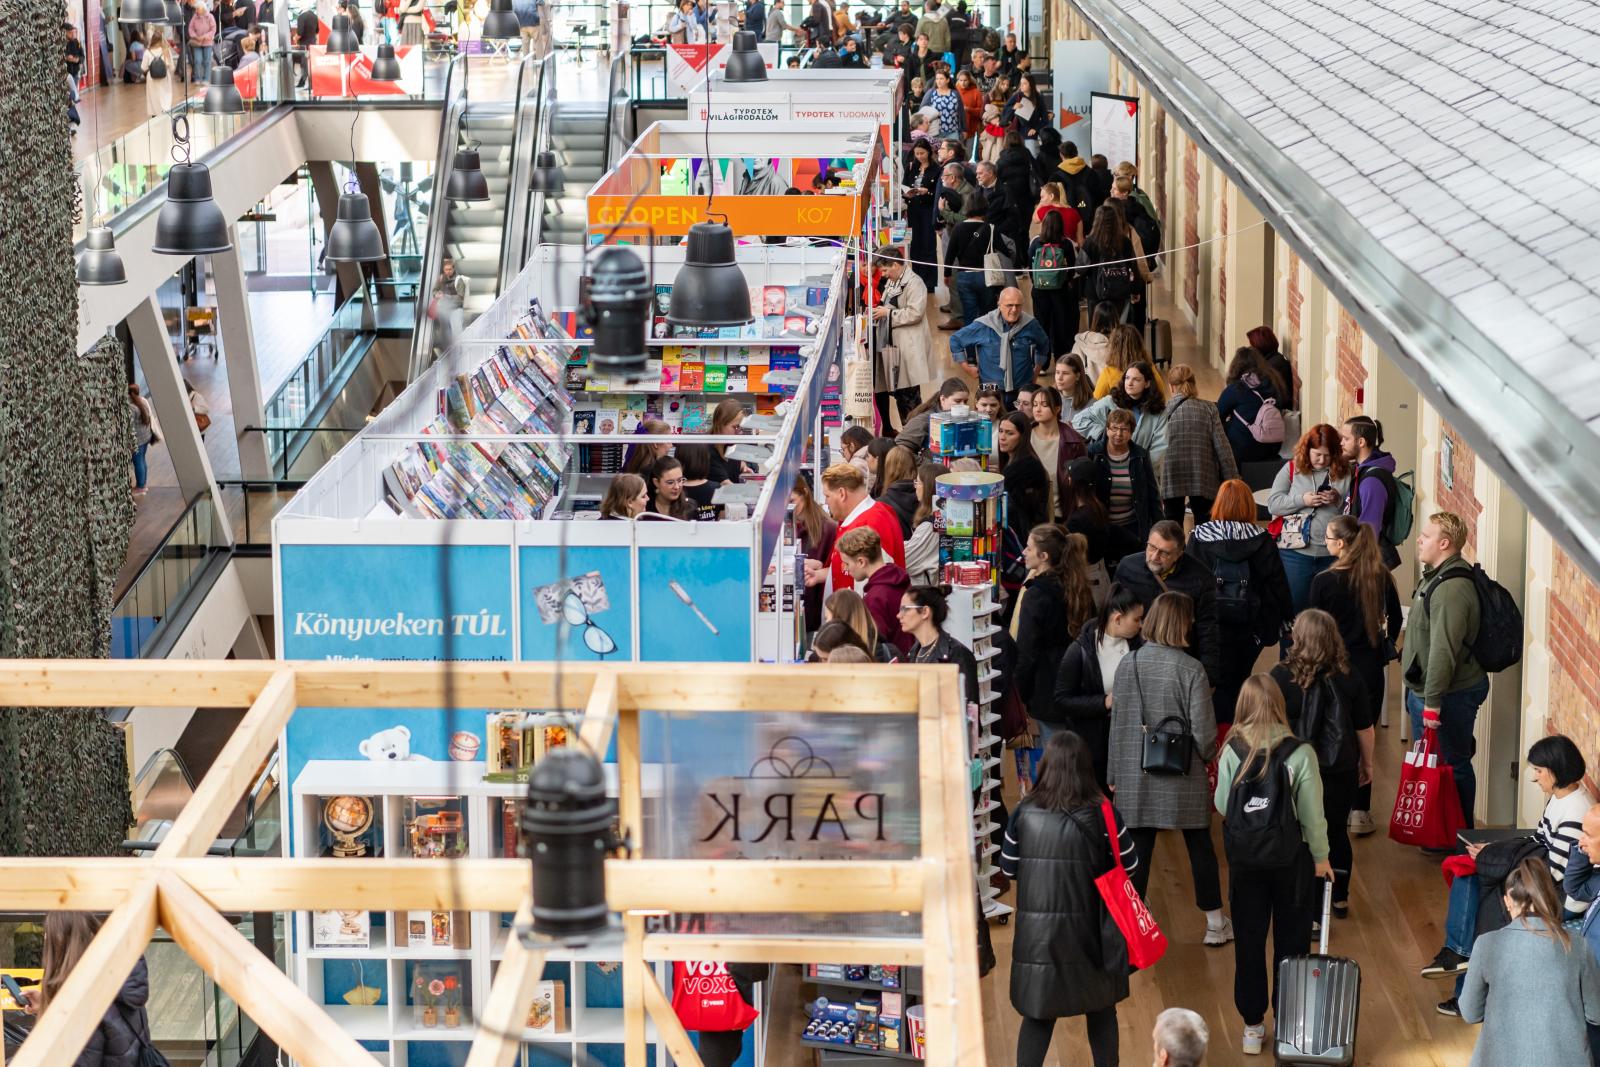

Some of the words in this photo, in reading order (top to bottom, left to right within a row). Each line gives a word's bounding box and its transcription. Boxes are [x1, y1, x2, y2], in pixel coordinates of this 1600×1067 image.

[709, 113, 778, 121] VILÁGIRODALOM
[838, 109, 886, 118] TUDOMÁNY
[596, 206, 697, 225] GEOPEN
[294, 612, 444, 641] Könyveken
[451, 608, 506, 636] TÚL
[1249, 796, 1268, 807] NIKE
